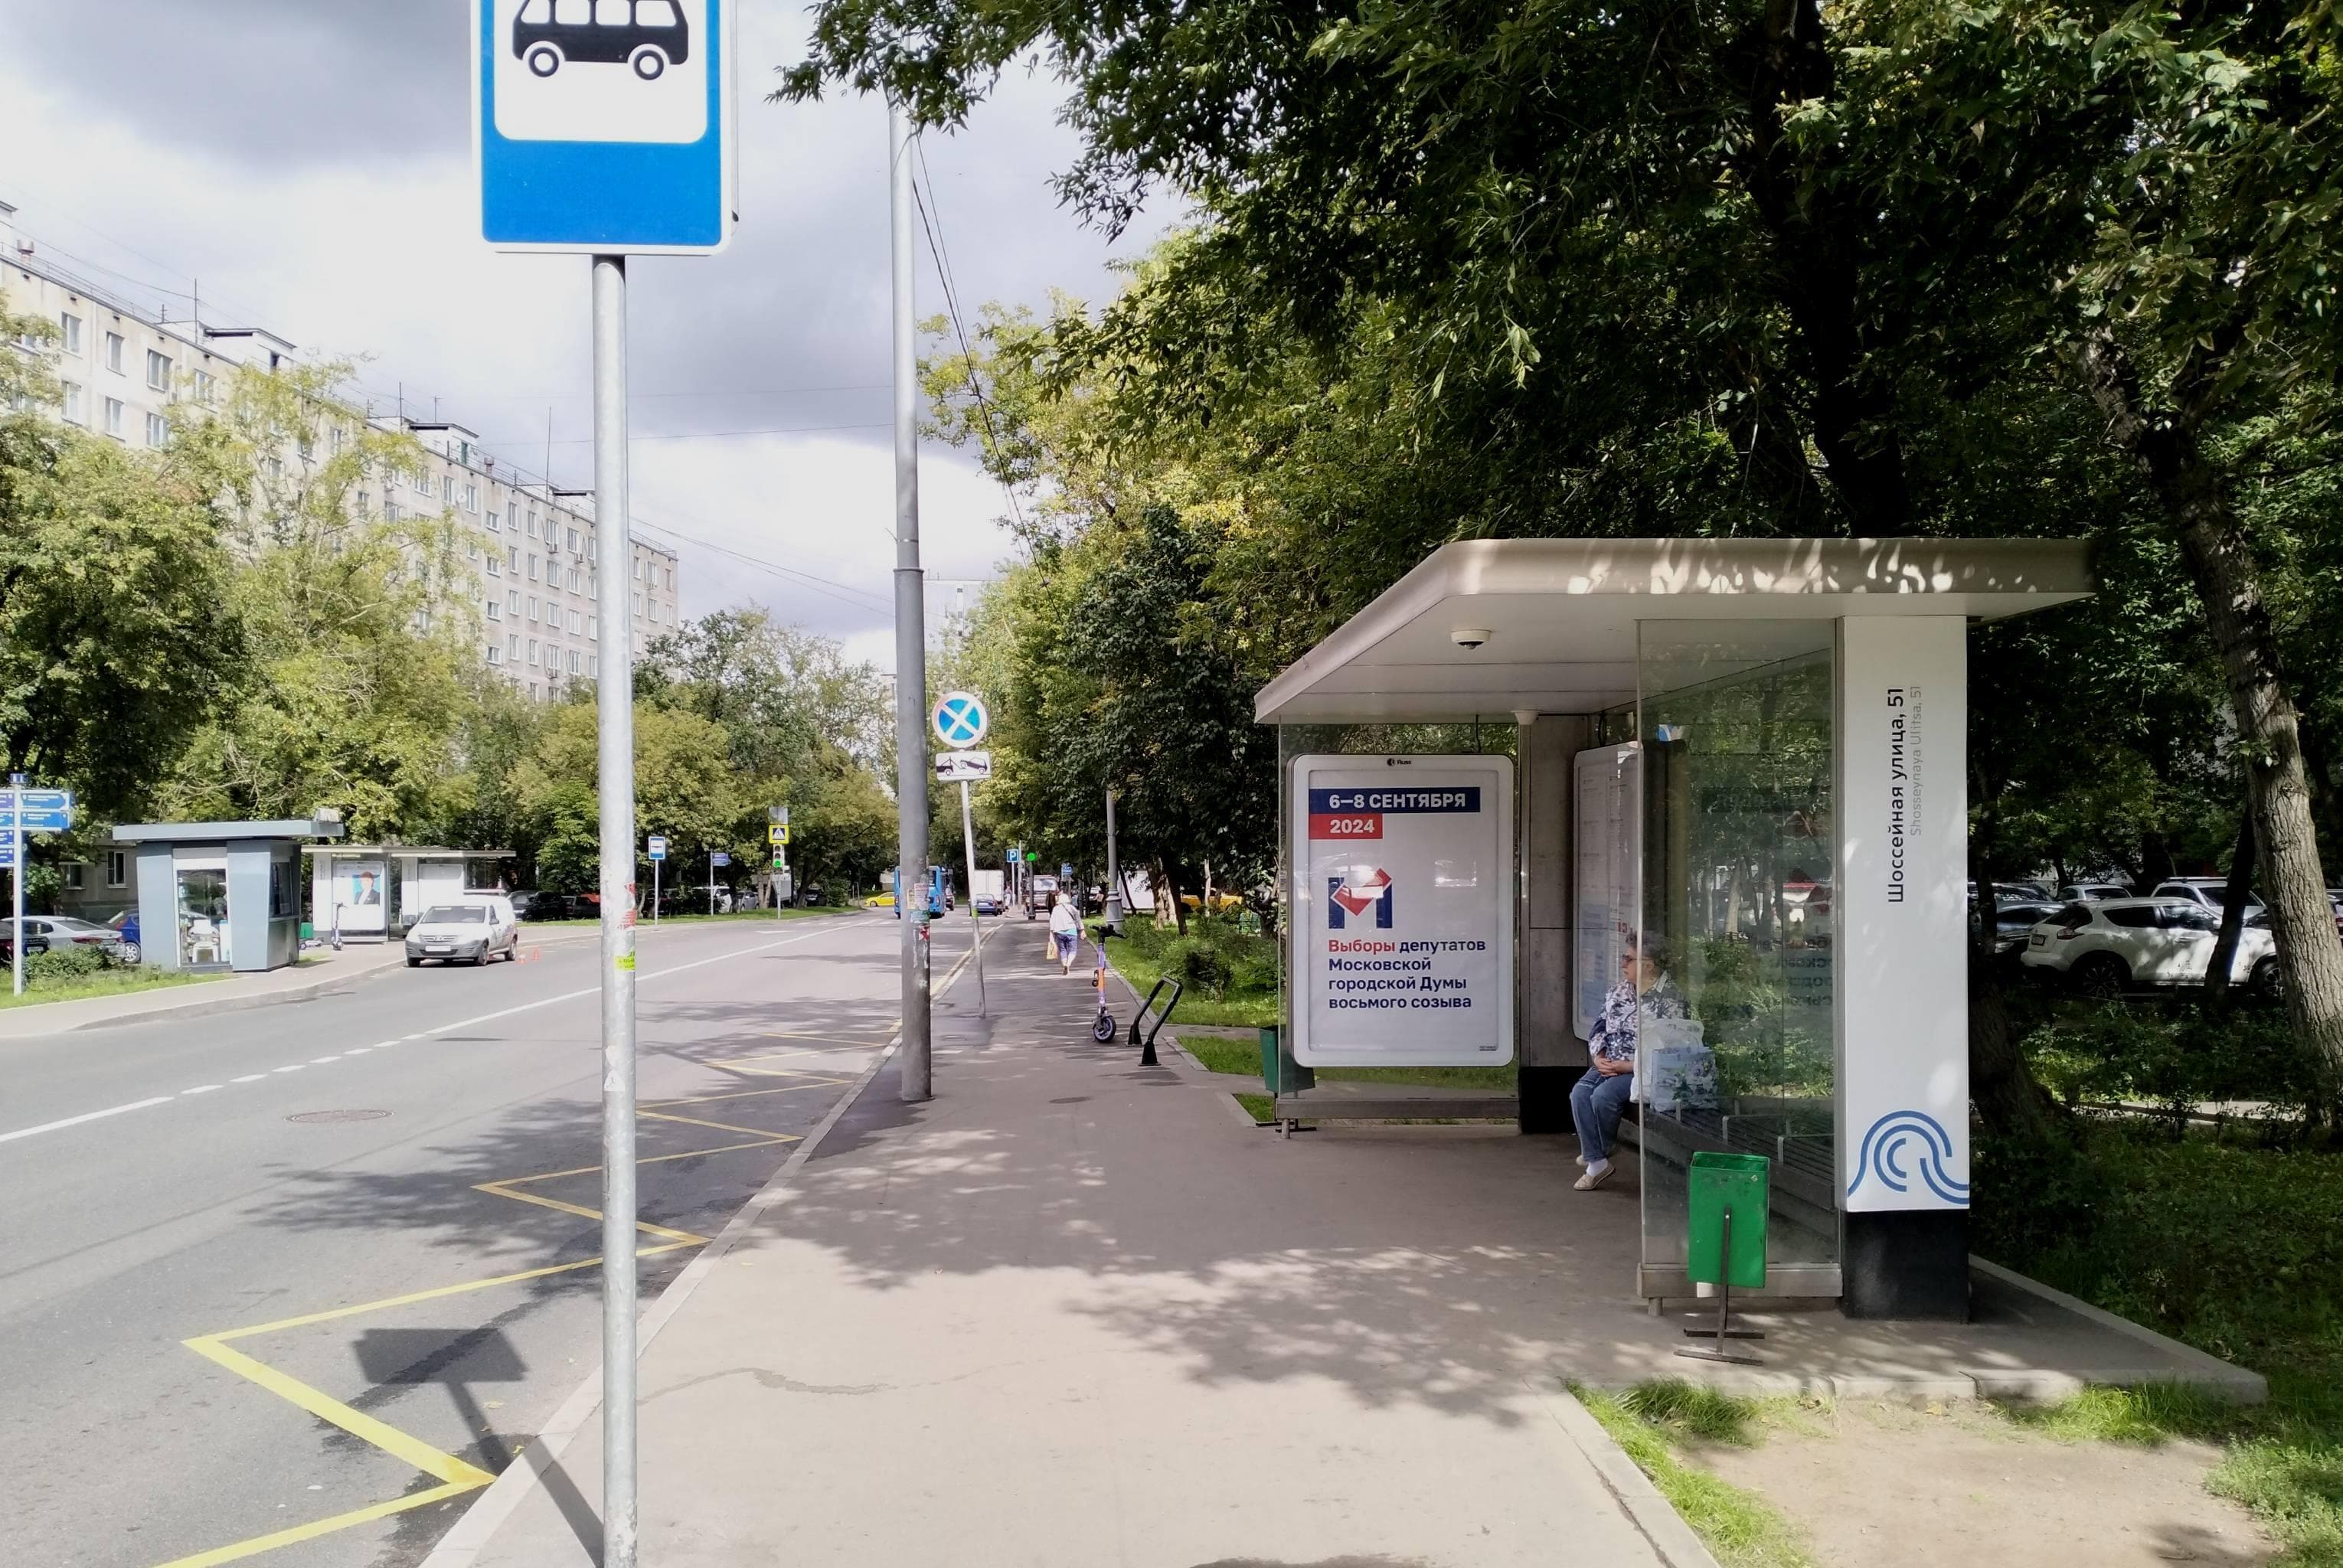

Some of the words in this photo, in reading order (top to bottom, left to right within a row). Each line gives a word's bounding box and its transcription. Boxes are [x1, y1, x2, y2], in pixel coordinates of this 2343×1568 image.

[1887, 688, 1904, 707] 51
[1910, 686, 1922, 698] 51
[1910, 702, 1923, 745] Ulitsa,
[1891, 714, 1907, 781] улица,
[1368, 793, 1466, 808] СЕНТЯБРЯ
[1910, 750, 1923, 836] Shosseynaya
[1329, 819, 1374, 834] 2024
[1887, 786, 1904, 903] Шоссейная
[1328, 939, 1396, 955] Выборы
[1399, 940, 1486, 955] депутатов
[1328, 957, 1431, 971] Московской
[1328, 976, 1416, 993] городской
[1420, 976, 1467, 992] Думы
[1328, 998, 1407, 1008] восьмого
[1410, 997, 1472, 1008] созыва
